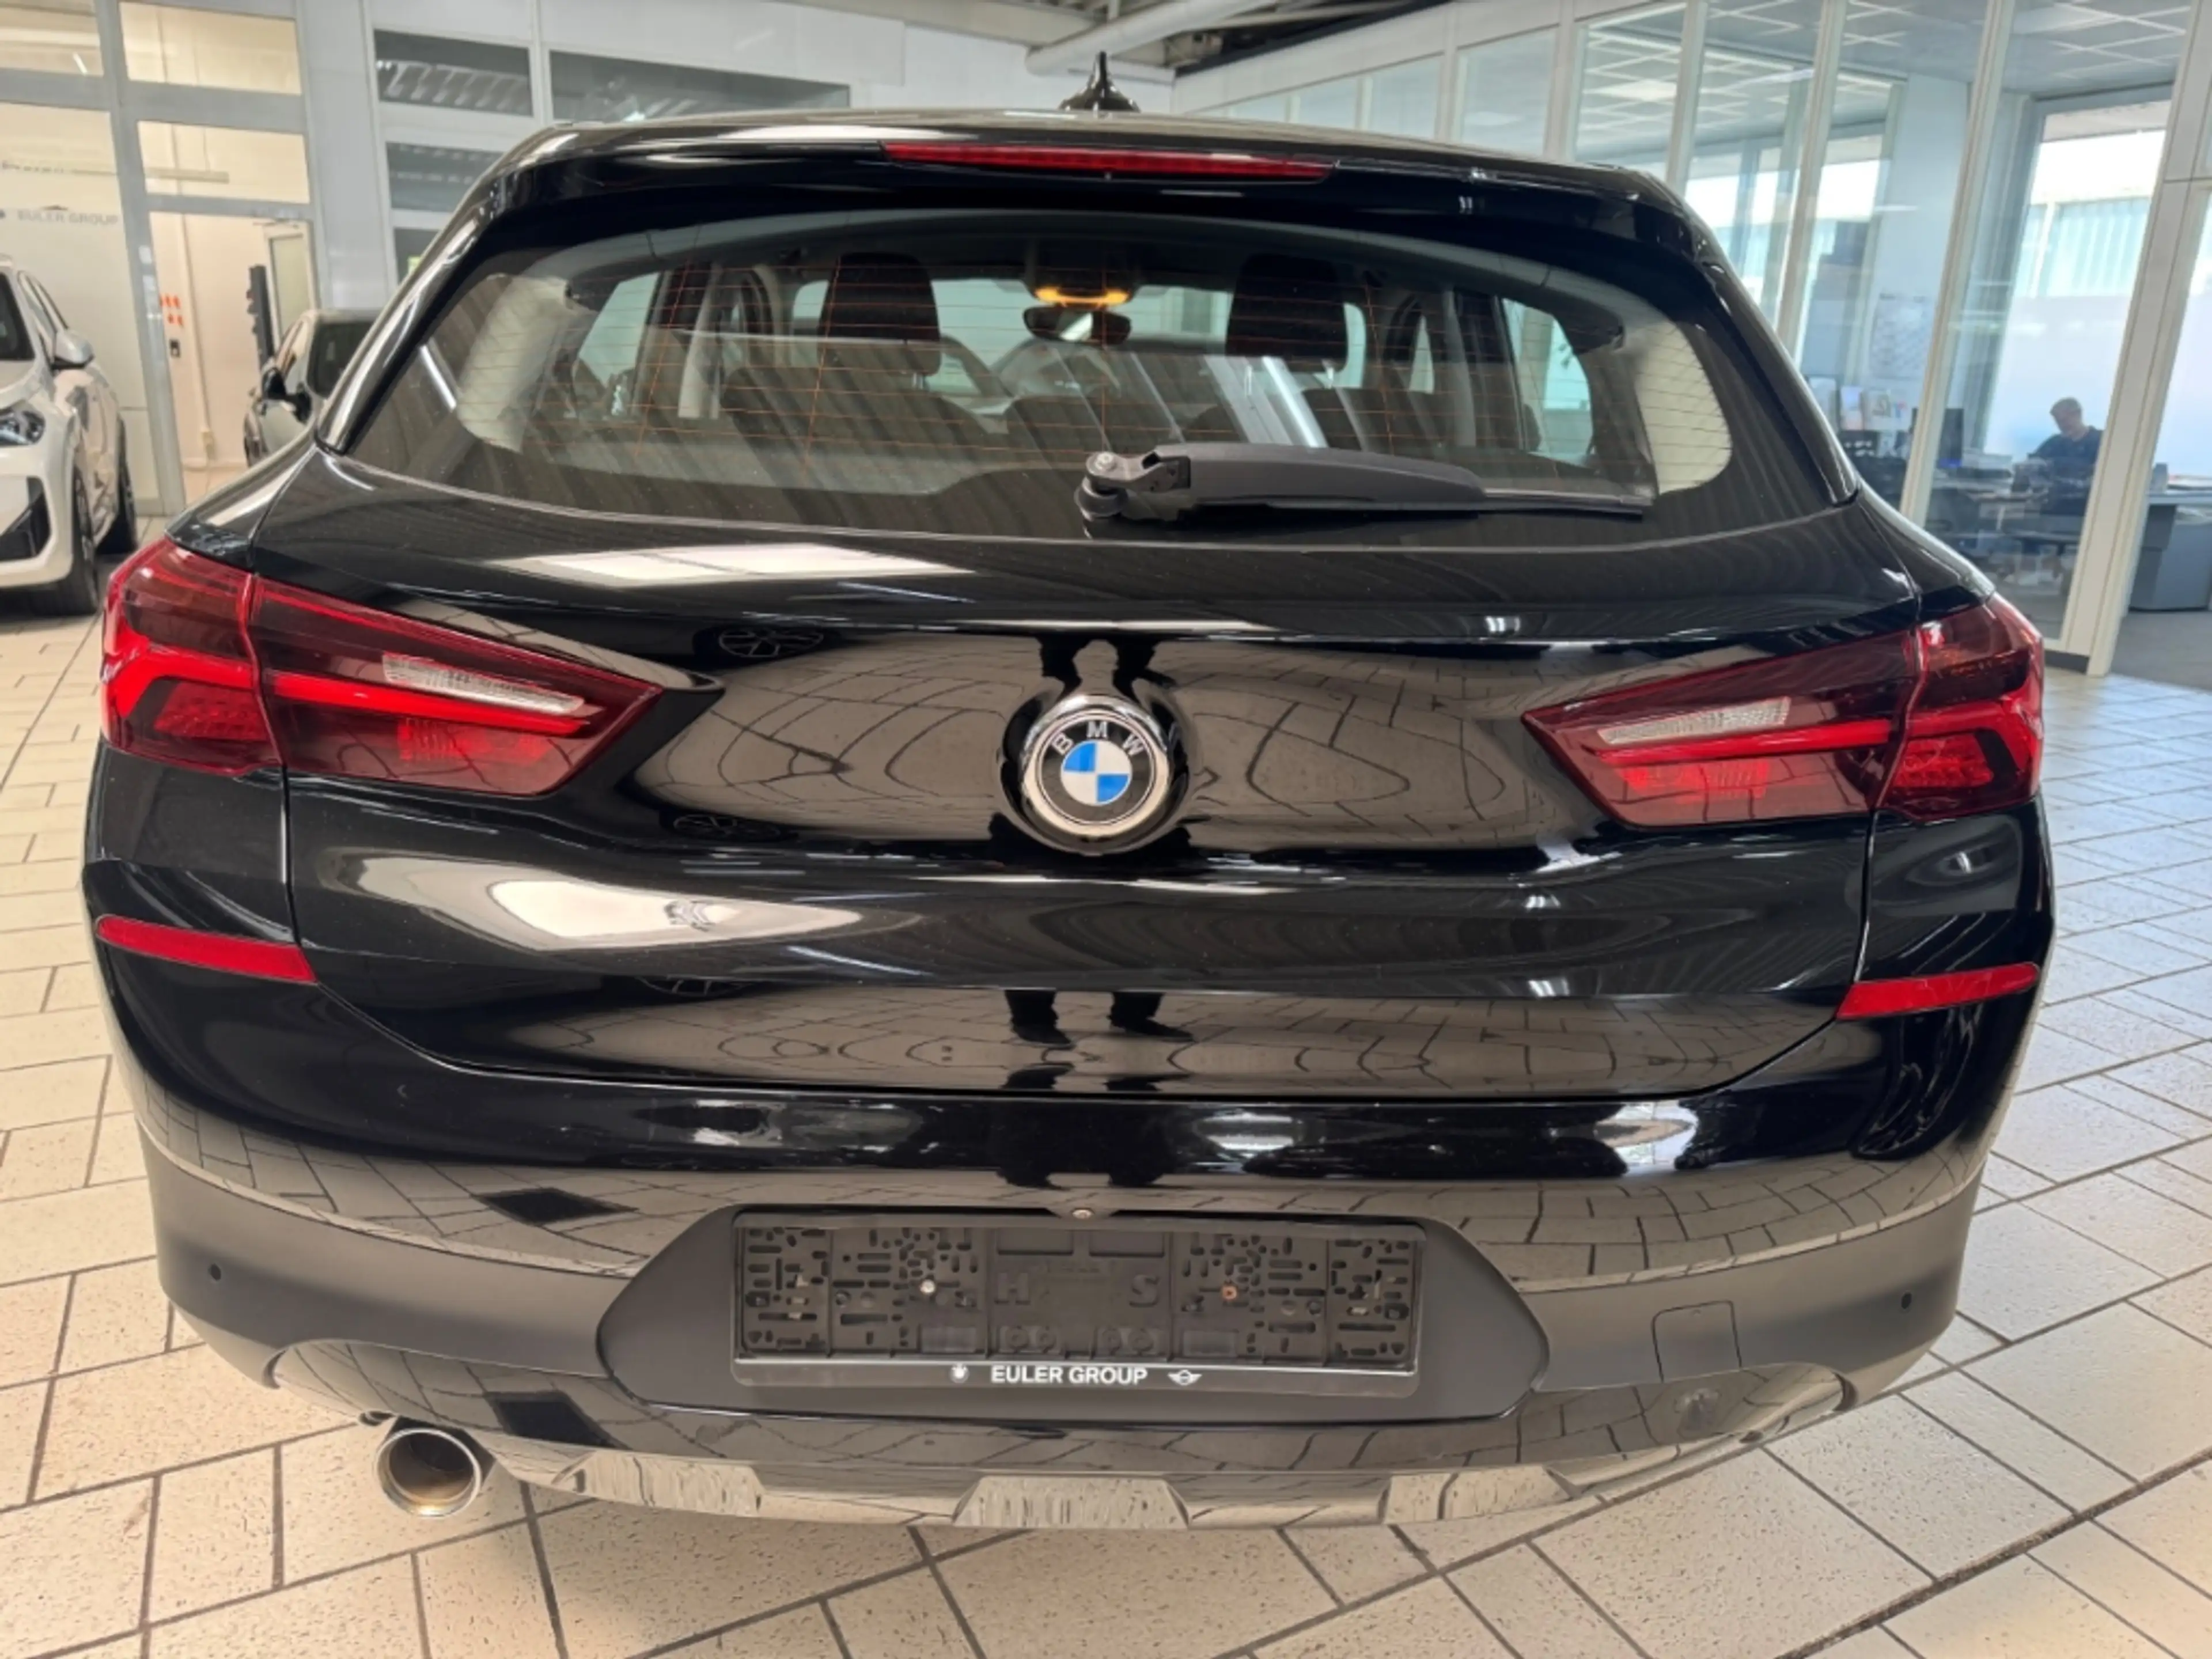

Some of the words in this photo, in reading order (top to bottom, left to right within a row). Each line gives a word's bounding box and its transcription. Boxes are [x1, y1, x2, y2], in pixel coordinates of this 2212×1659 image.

[1051, 721, 1145, 755] BMW
[991, 1365, 1063, 1383] EULER
[1069, 1366, 1147, 1385] GROUP
